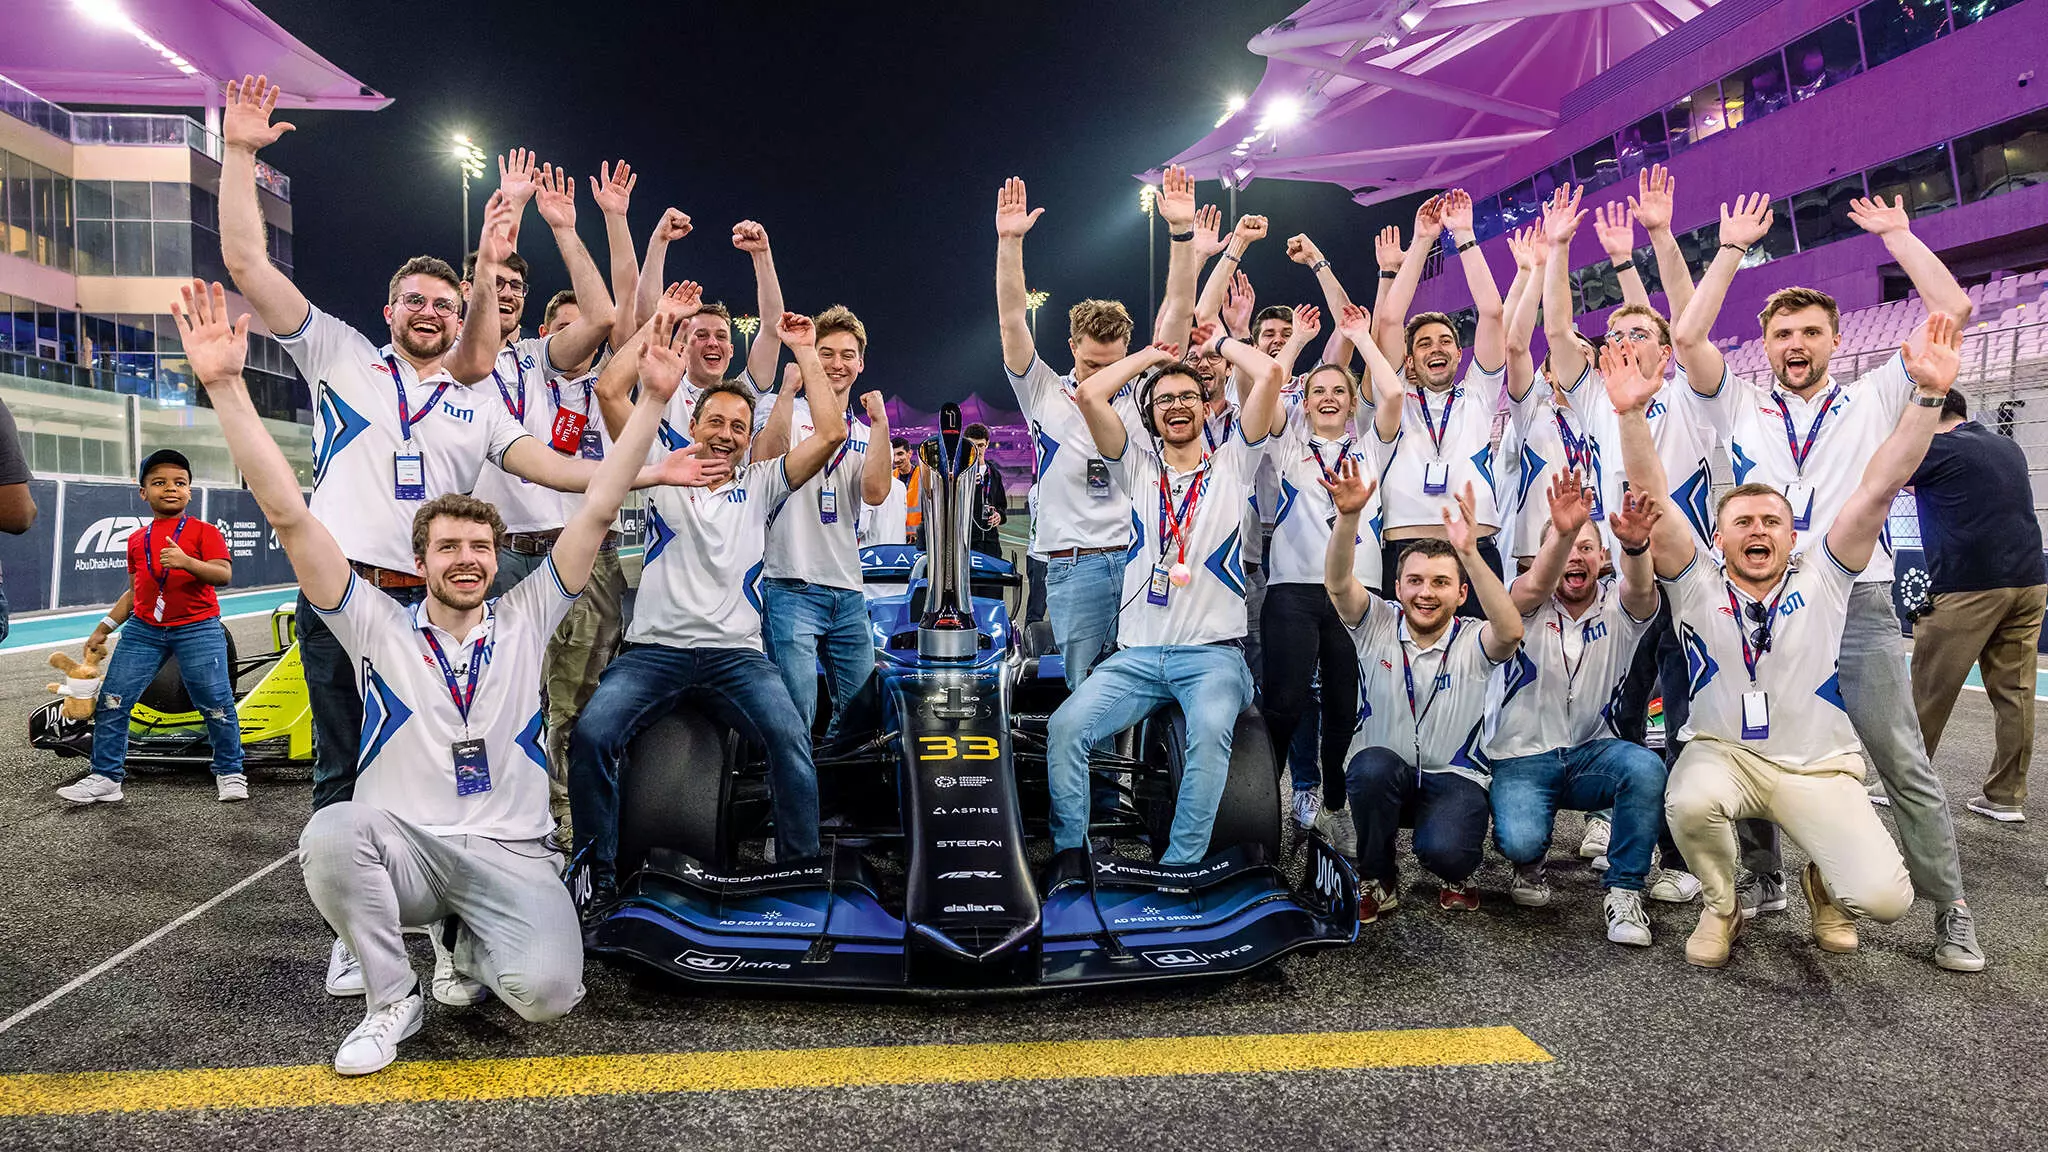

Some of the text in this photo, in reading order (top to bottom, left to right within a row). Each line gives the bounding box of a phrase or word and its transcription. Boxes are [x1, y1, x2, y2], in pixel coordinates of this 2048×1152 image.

[443, 401, 474, 423] TUM
[561, 413, 577, 442] PITLANE
[572, 426, 580, 436] 33
[75, 557, 128, 570] Abu Dhabi Auton
[1779, 590, 1806, 617] TUM
[919, 736, 1000, 761] 33
[936, 840, 1002, 848] STEERAI
[704, 870, 801, 883] MECCANICA
[1117, 861, 1230, 879] MECCANICA 42
[943, 903, 1005, 912] dallara
[1166, 914, 1202, 922] GROUP
[1156, 944, 1253, 965] du infra
[685, 957, 791, 970] du infra
